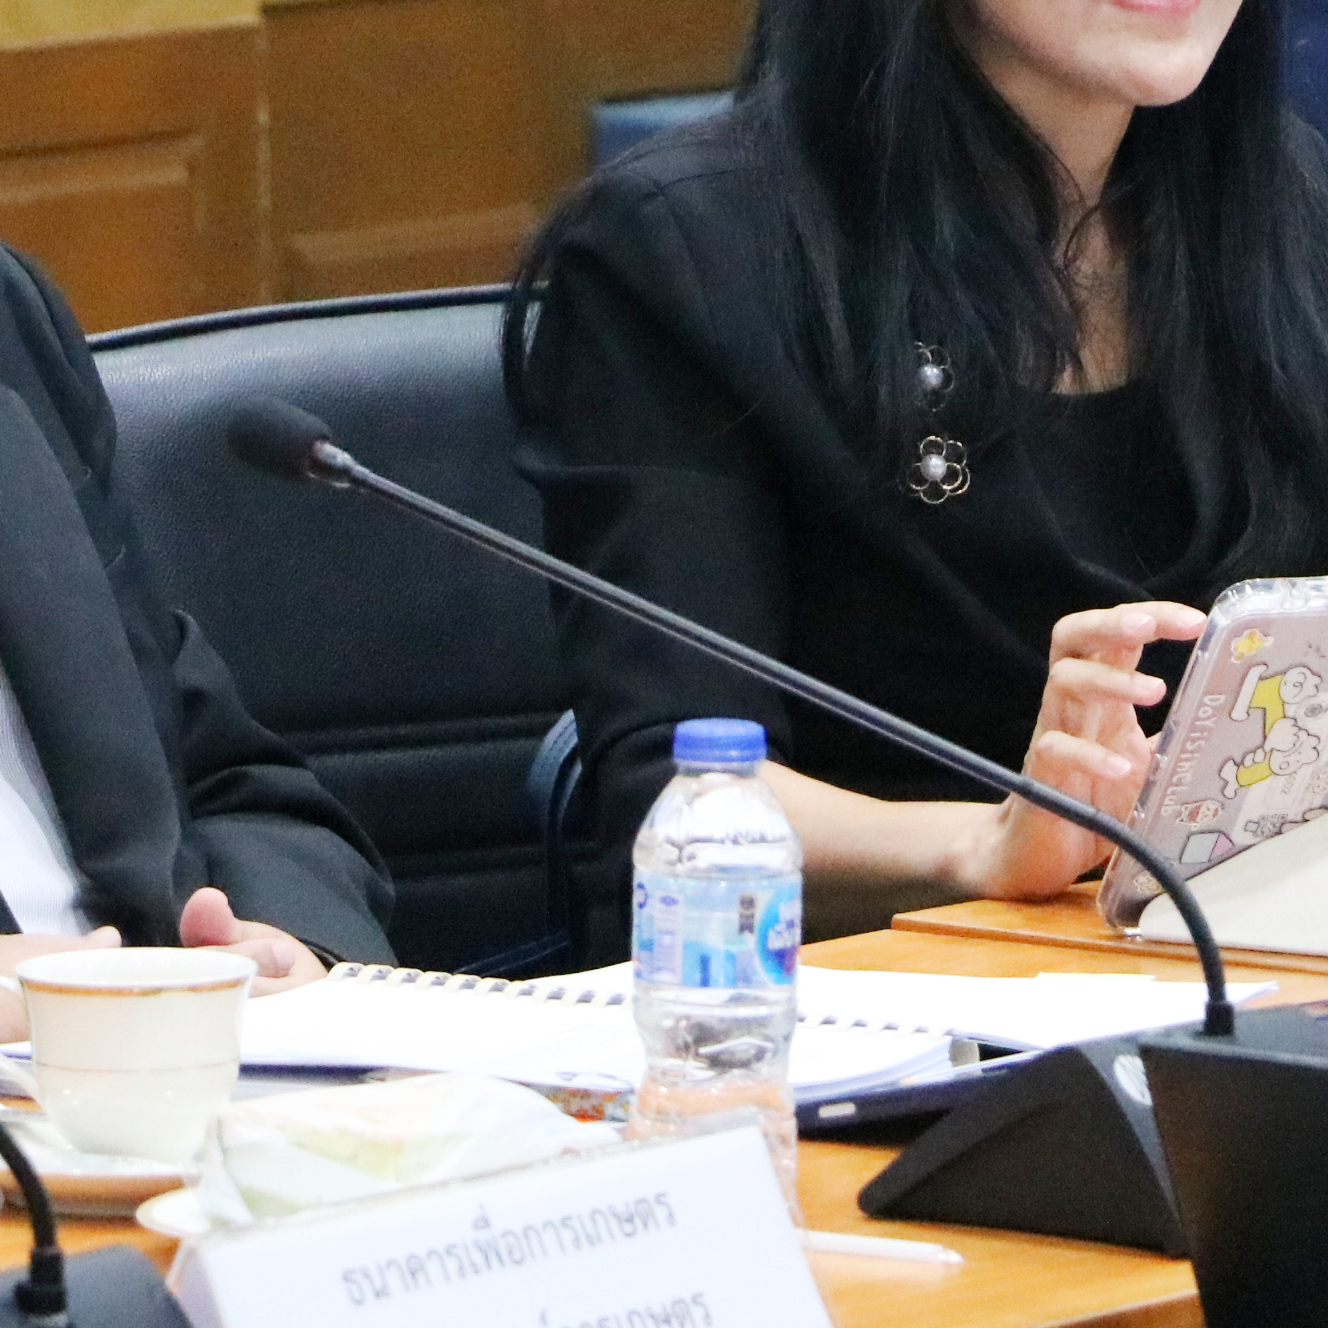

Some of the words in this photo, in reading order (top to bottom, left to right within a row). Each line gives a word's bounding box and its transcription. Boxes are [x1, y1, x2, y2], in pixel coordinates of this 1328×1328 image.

[341, 1191, 677, 1306] ธนาคารเพื่อการเกษตร
